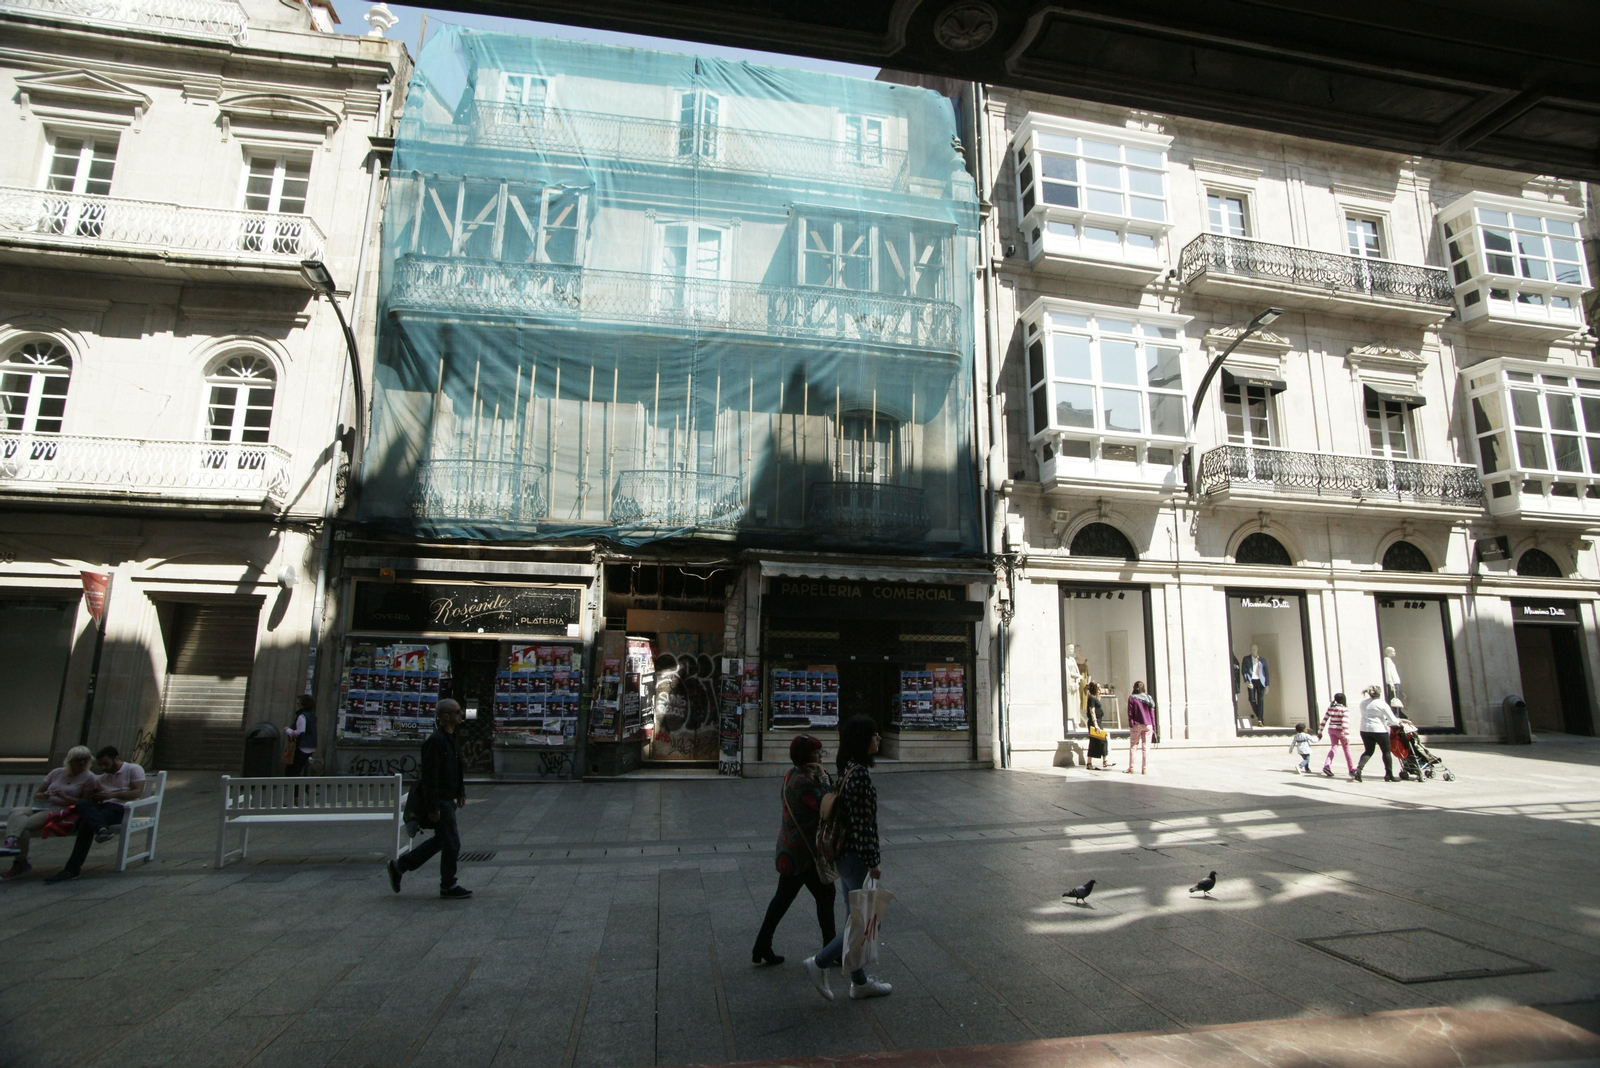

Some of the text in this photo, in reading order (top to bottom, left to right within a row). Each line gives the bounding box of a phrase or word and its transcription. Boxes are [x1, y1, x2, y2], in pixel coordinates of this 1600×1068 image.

[781, 583, 956, 601] PAPELERIA COMERCIAL
[1242, 598, 1290, 608] Massimo Dutti
[1524, 606, 1550, 615] Massimo
[368, 612, 411, 621] JOYERIA
[520, 616, 565, 626] PLATERIA
[397, 654, 419, 671] 14
[515, 649, 537, 666] 14
[401, 721, 418, 730] VIGO
